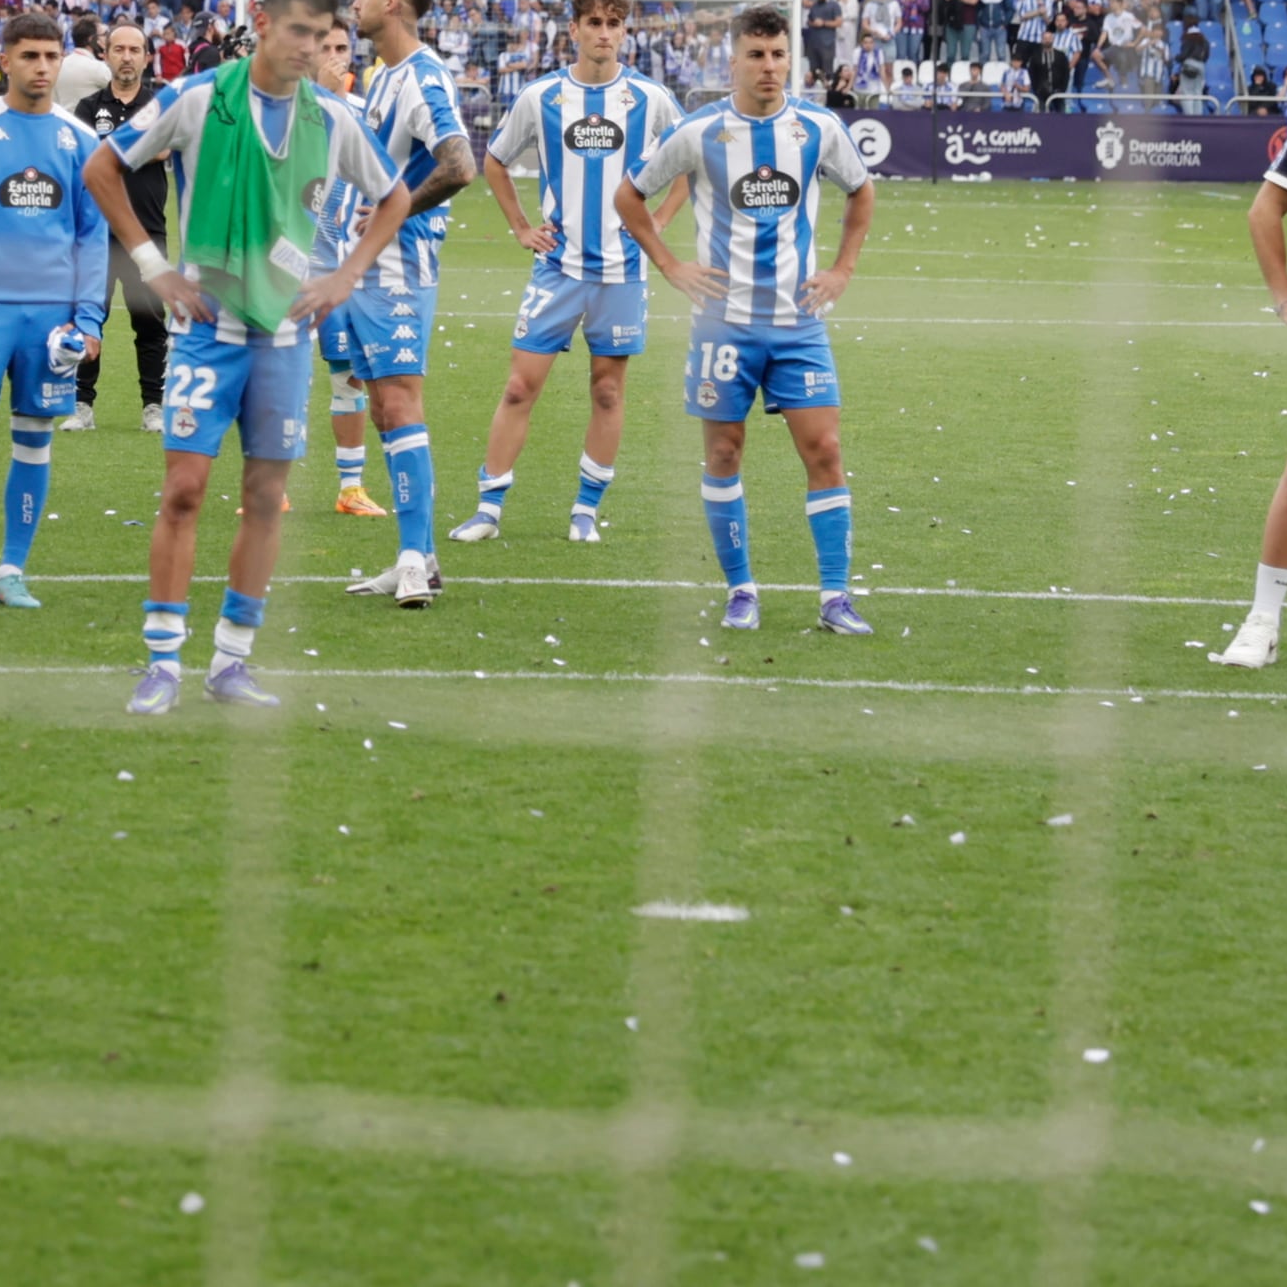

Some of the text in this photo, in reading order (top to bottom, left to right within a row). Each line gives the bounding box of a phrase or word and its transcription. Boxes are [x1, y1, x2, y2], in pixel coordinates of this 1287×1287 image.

[573, 125, 615, 136] Estrella
[972, 130, 987, 146] A
[574, 136, 613, 147] Galicia
[1129, 139, 1201, 157] Deputación
[1129, 150, 1201, 167] DA CORUÑA
[7, 181, 54, 194] Estrella
[741, 179, 790, 194] Estrella
[9, 192, 52, 207] Galicia
[743, 192, 788, 206] Galicia
[518, 283, 554, 319] 27
[700, 342, 738, 381] 18
[169, 364, 216, 410] 22
